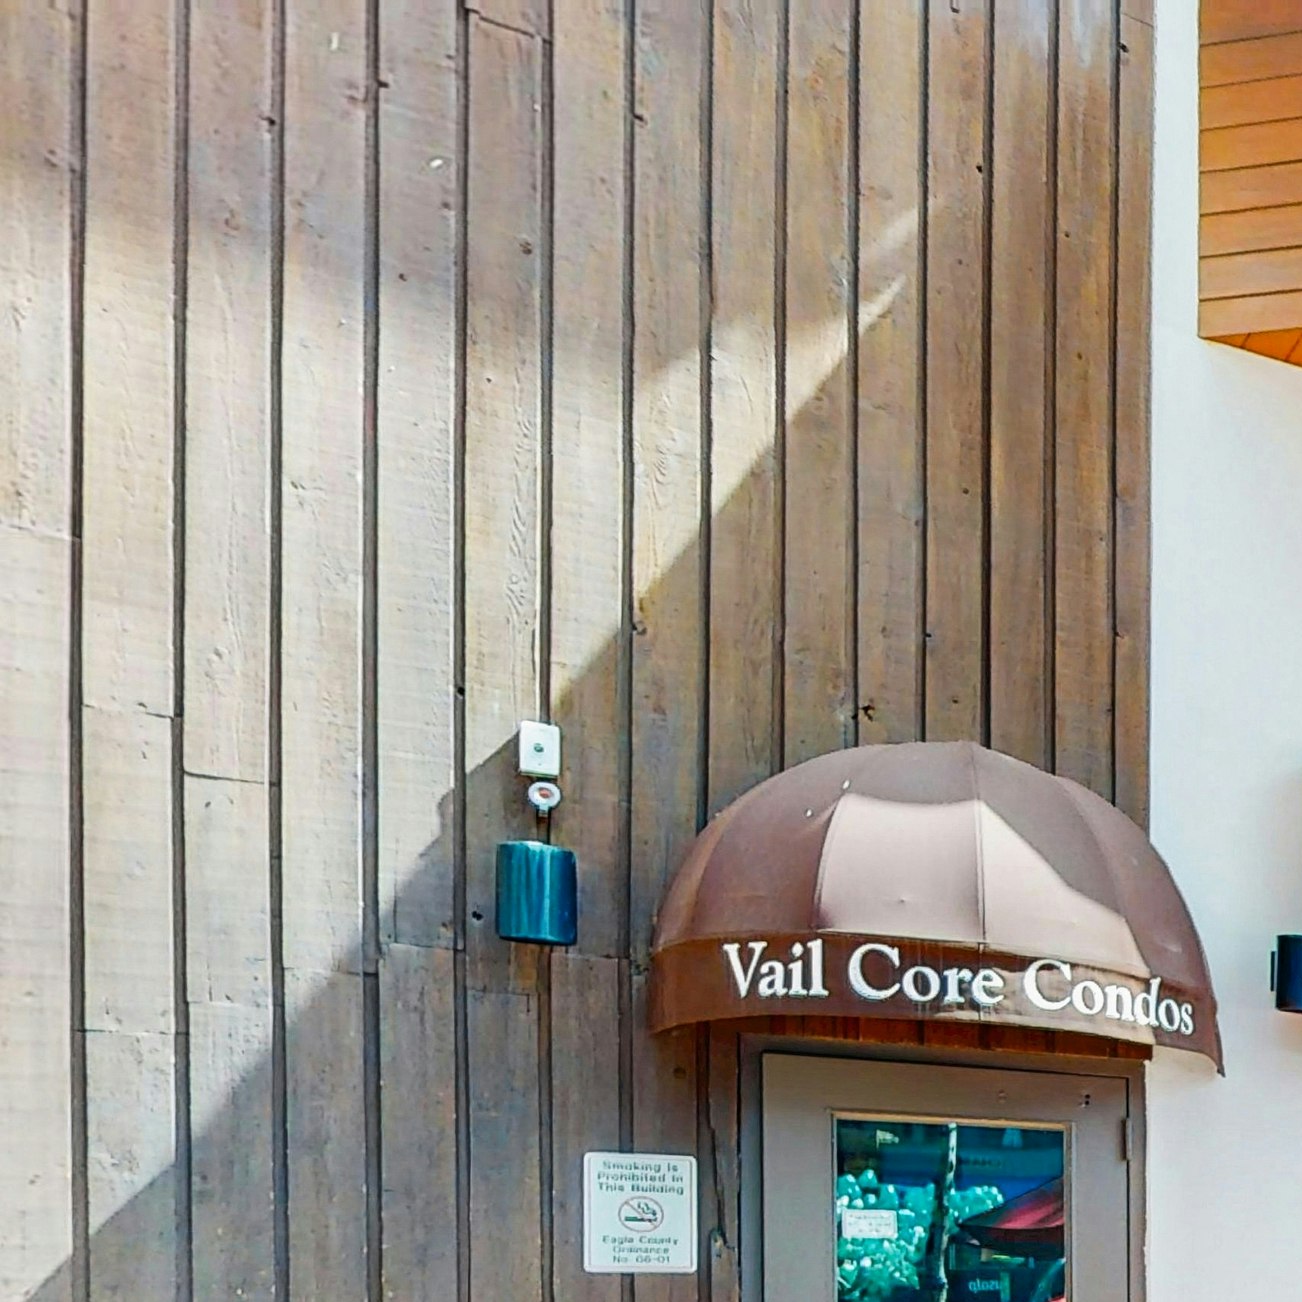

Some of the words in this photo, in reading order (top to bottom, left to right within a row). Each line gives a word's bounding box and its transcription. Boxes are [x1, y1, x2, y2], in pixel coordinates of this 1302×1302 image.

[723, 938, 830, 999] Vail
[847, 942, 1005, 1006] Core
[1023, 958, 1195, 1037] Condos
[602, 1161, 662, 1173] Smoking
[597, 1171, 666, 1182] Prohibited
[599, 1182, 625, 1192] This
[631, 1183, 684, 1196] Building
[602, 1235, 635, 1245] Eagle
[639, 1235, 679, 1246] County
[612, 1245, 670, 1254] Ordinance
